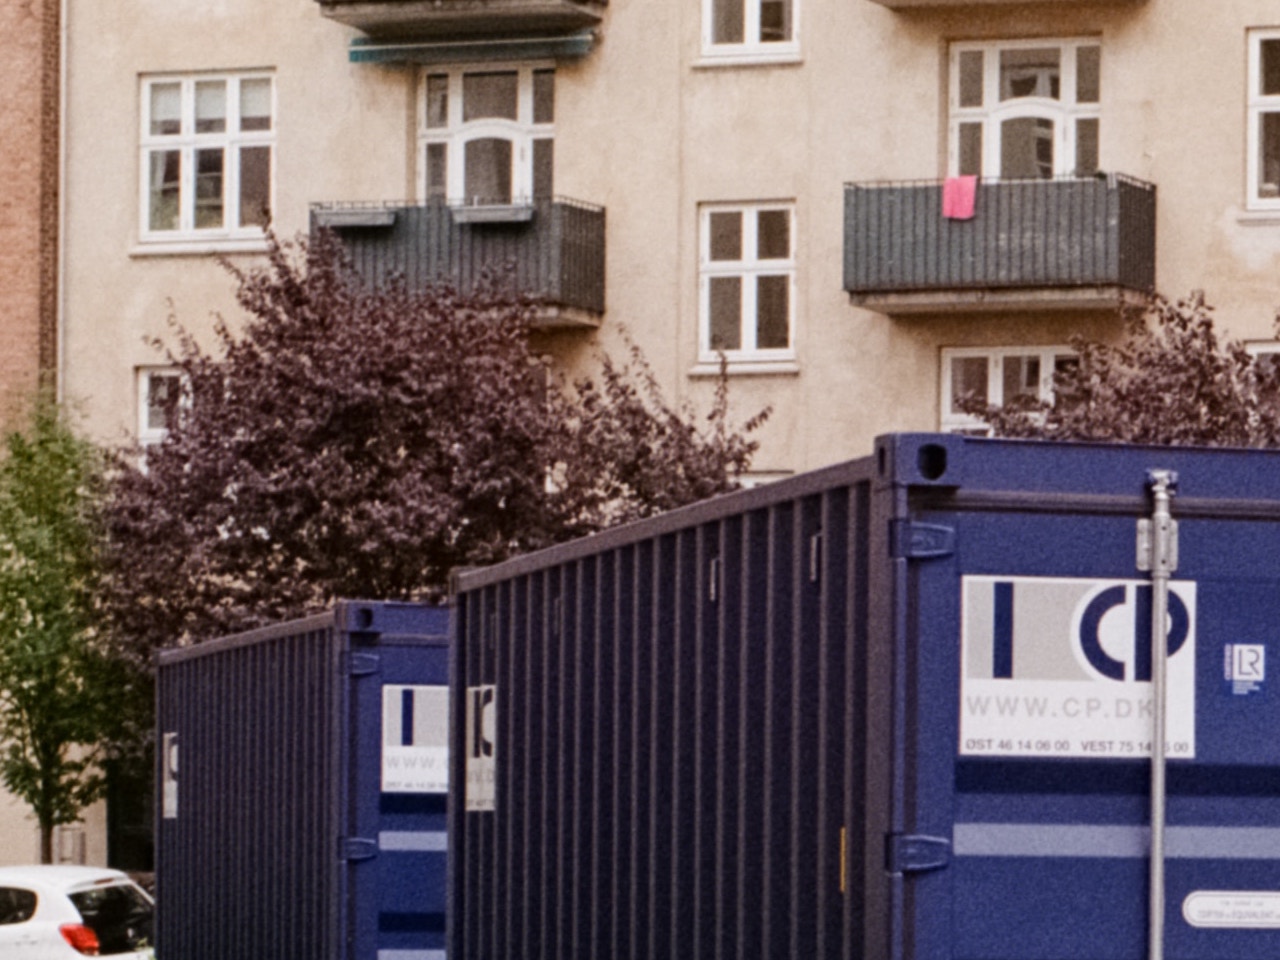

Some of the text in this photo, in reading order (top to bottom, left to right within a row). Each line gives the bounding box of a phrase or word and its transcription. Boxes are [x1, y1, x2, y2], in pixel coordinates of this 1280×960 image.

[966, 696, 1154, 719] WWW.CP.DK
[997, 739, 1013, 751] 46
[1018, 739, 1031, 751] 14
[1055, 740, 1070, 752] 00
[1081, 741, 1115, 753] VEST
[1119, 740, 1134, 753] 75
[1173, 742, 1189, 754] 00
